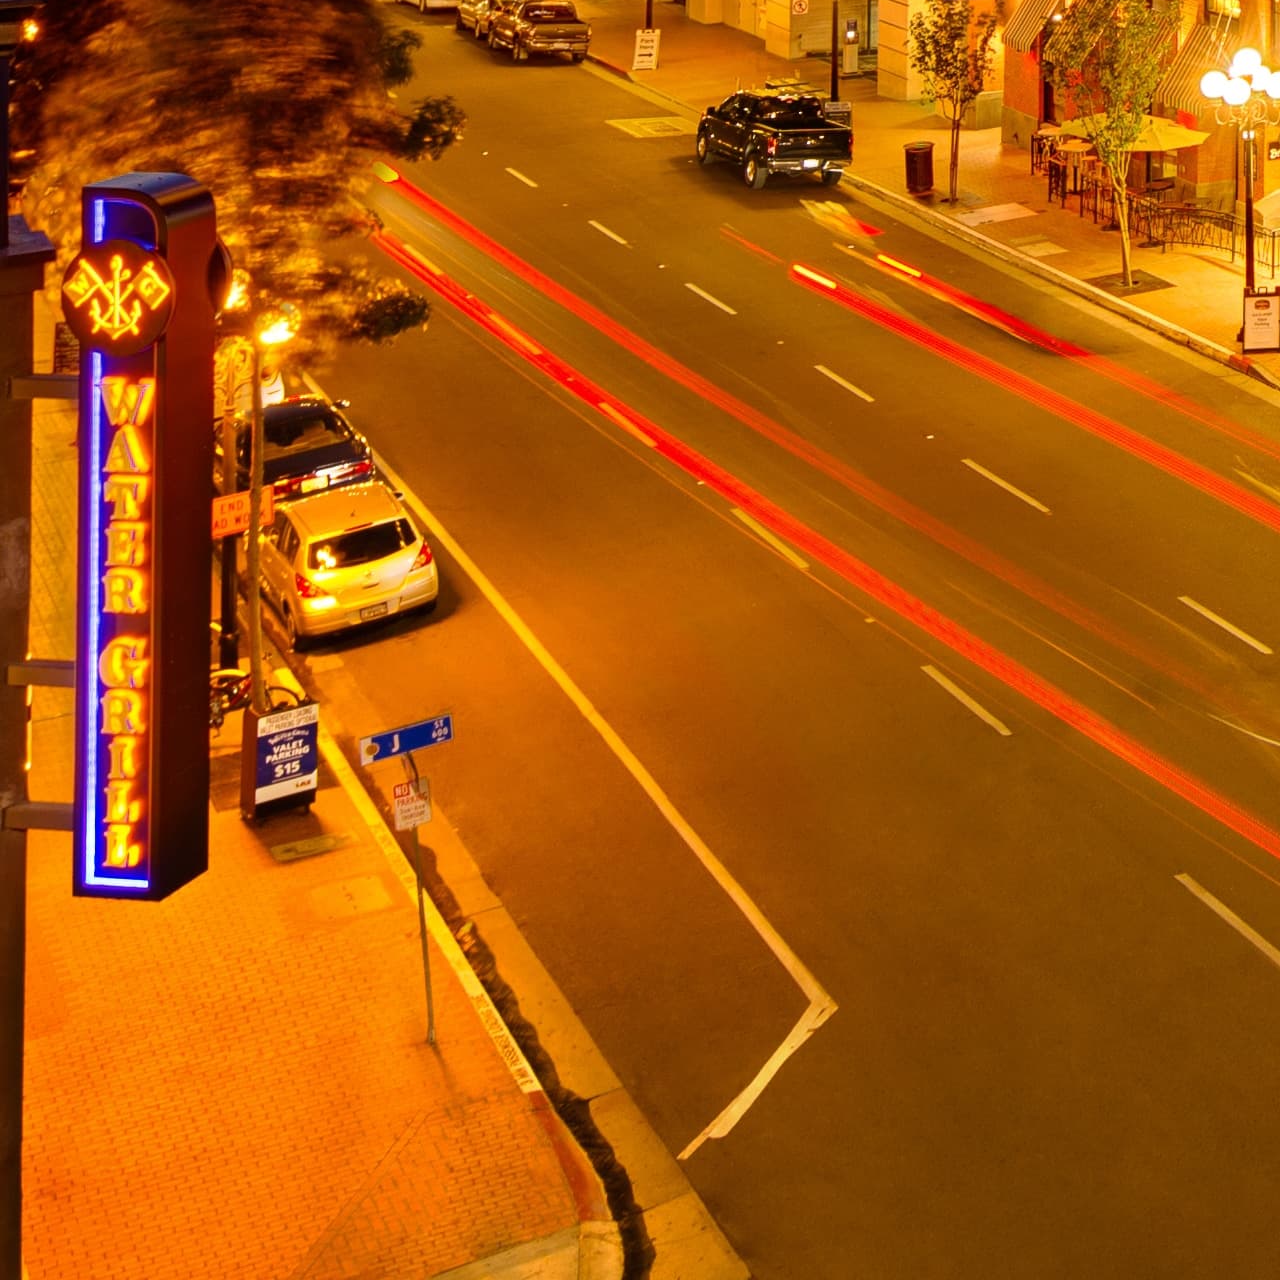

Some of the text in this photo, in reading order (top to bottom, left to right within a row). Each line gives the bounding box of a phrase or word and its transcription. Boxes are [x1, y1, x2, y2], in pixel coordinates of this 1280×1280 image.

[220, 500, 244, 513] END
[213, 519, 228, 529] AD
[98, 376, 157, 869] WATER GRILL
[433, 719, 444, 729] ST
[431, 726, 449, 739] 600
[272, 738, 305, 754] VALET
[391, 733, 400, 753] J
[265, 744, 311, 764] PARKING
[274, 759, 301, 778] $15
[394, 784, 409, 797] NO
